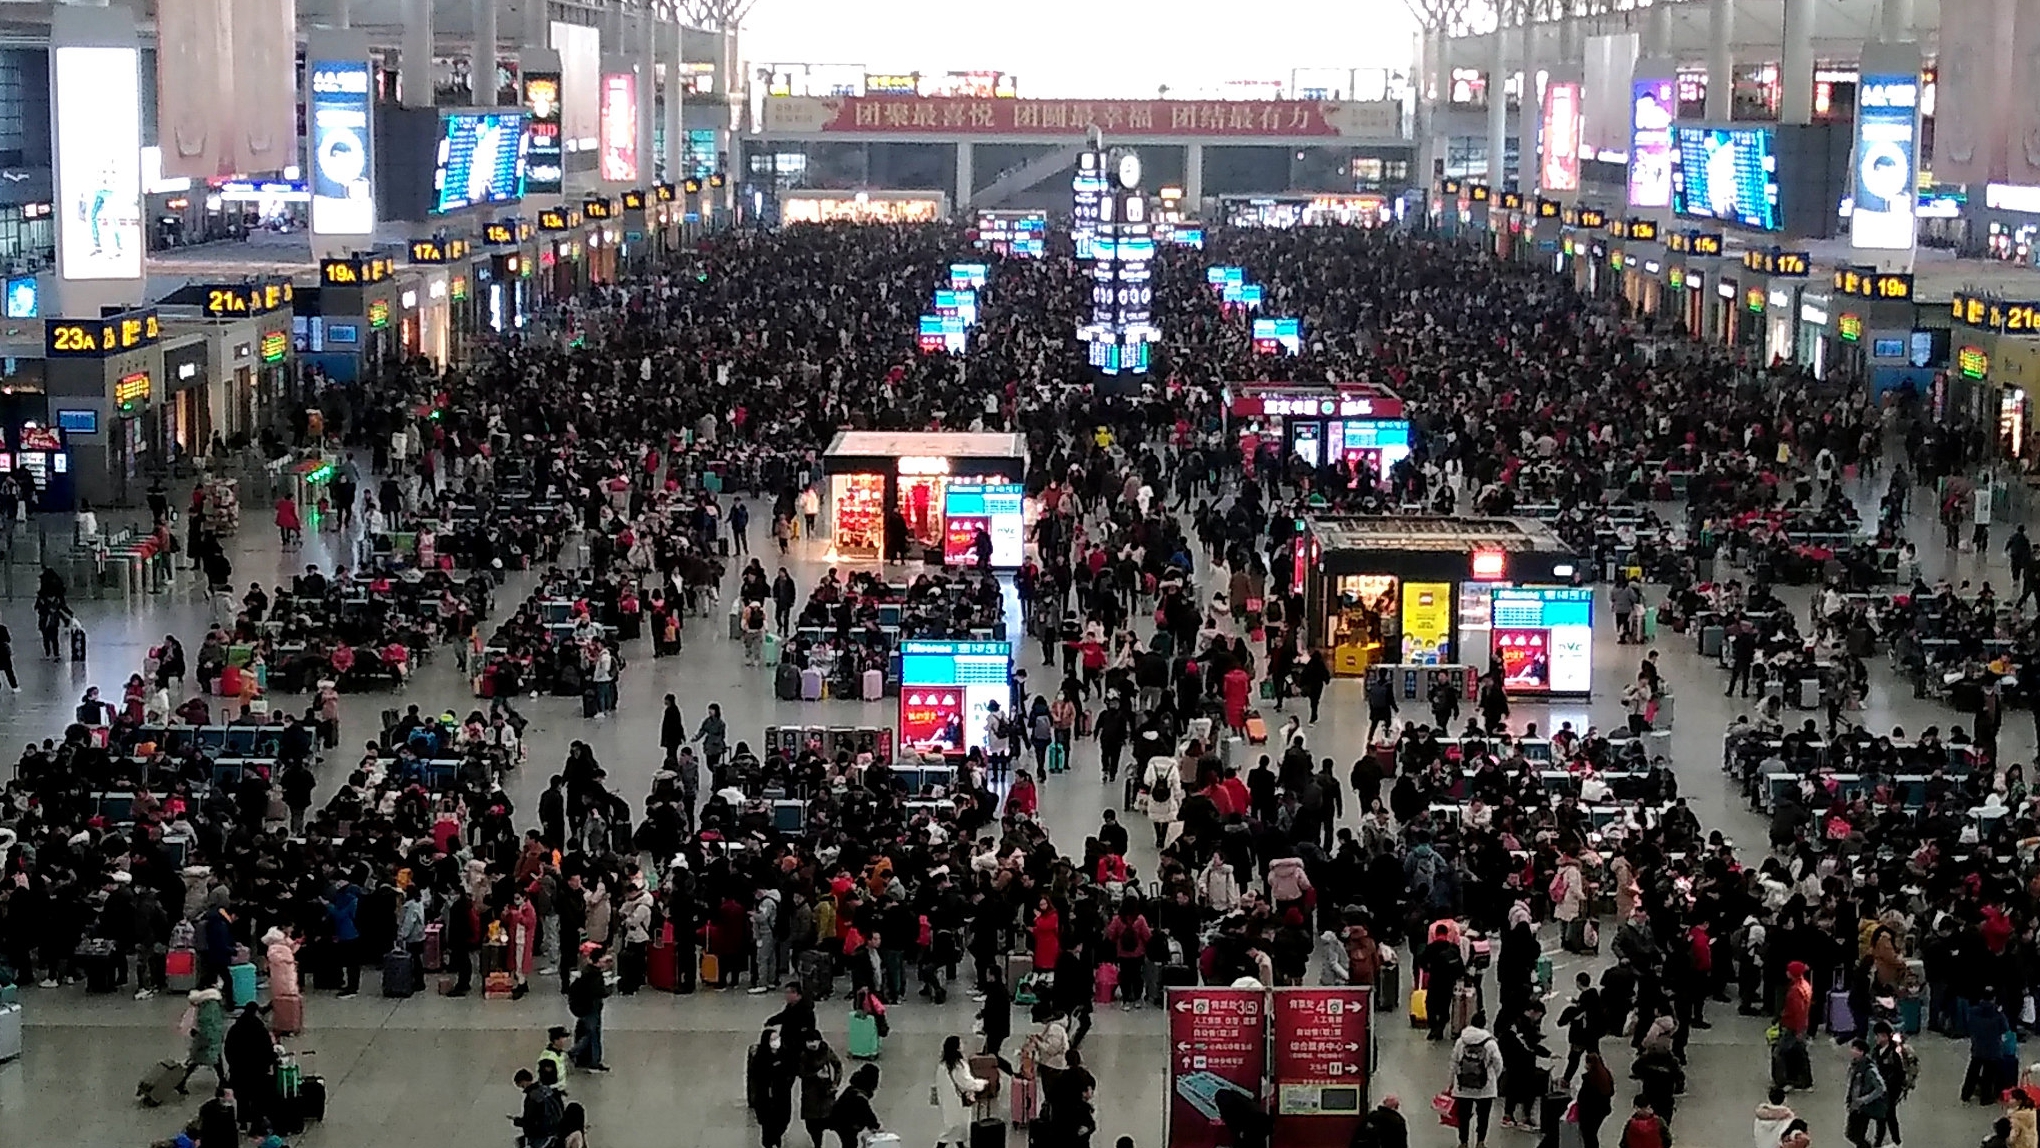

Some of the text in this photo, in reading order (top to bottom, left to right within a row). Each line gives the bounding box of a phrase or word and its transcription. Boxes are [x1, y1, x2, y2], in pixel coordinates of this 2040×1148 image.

[855, 102, 1310, 130] 团聚最喜悦 团圆最幸福 团结最有力
[542, 213, 564, 228] 13A
[487, 226, 510, 241] 15A
[414, 243, 440, 260] 17A
[325, 263, 356, 282] 19A
[1877, 277, 1907, 297] 19B
[208, 290, 245, 311] 21A
[53, 326, 96, 350] 23A
[1289, 1041, 1344, 1052] 综合服务中心
